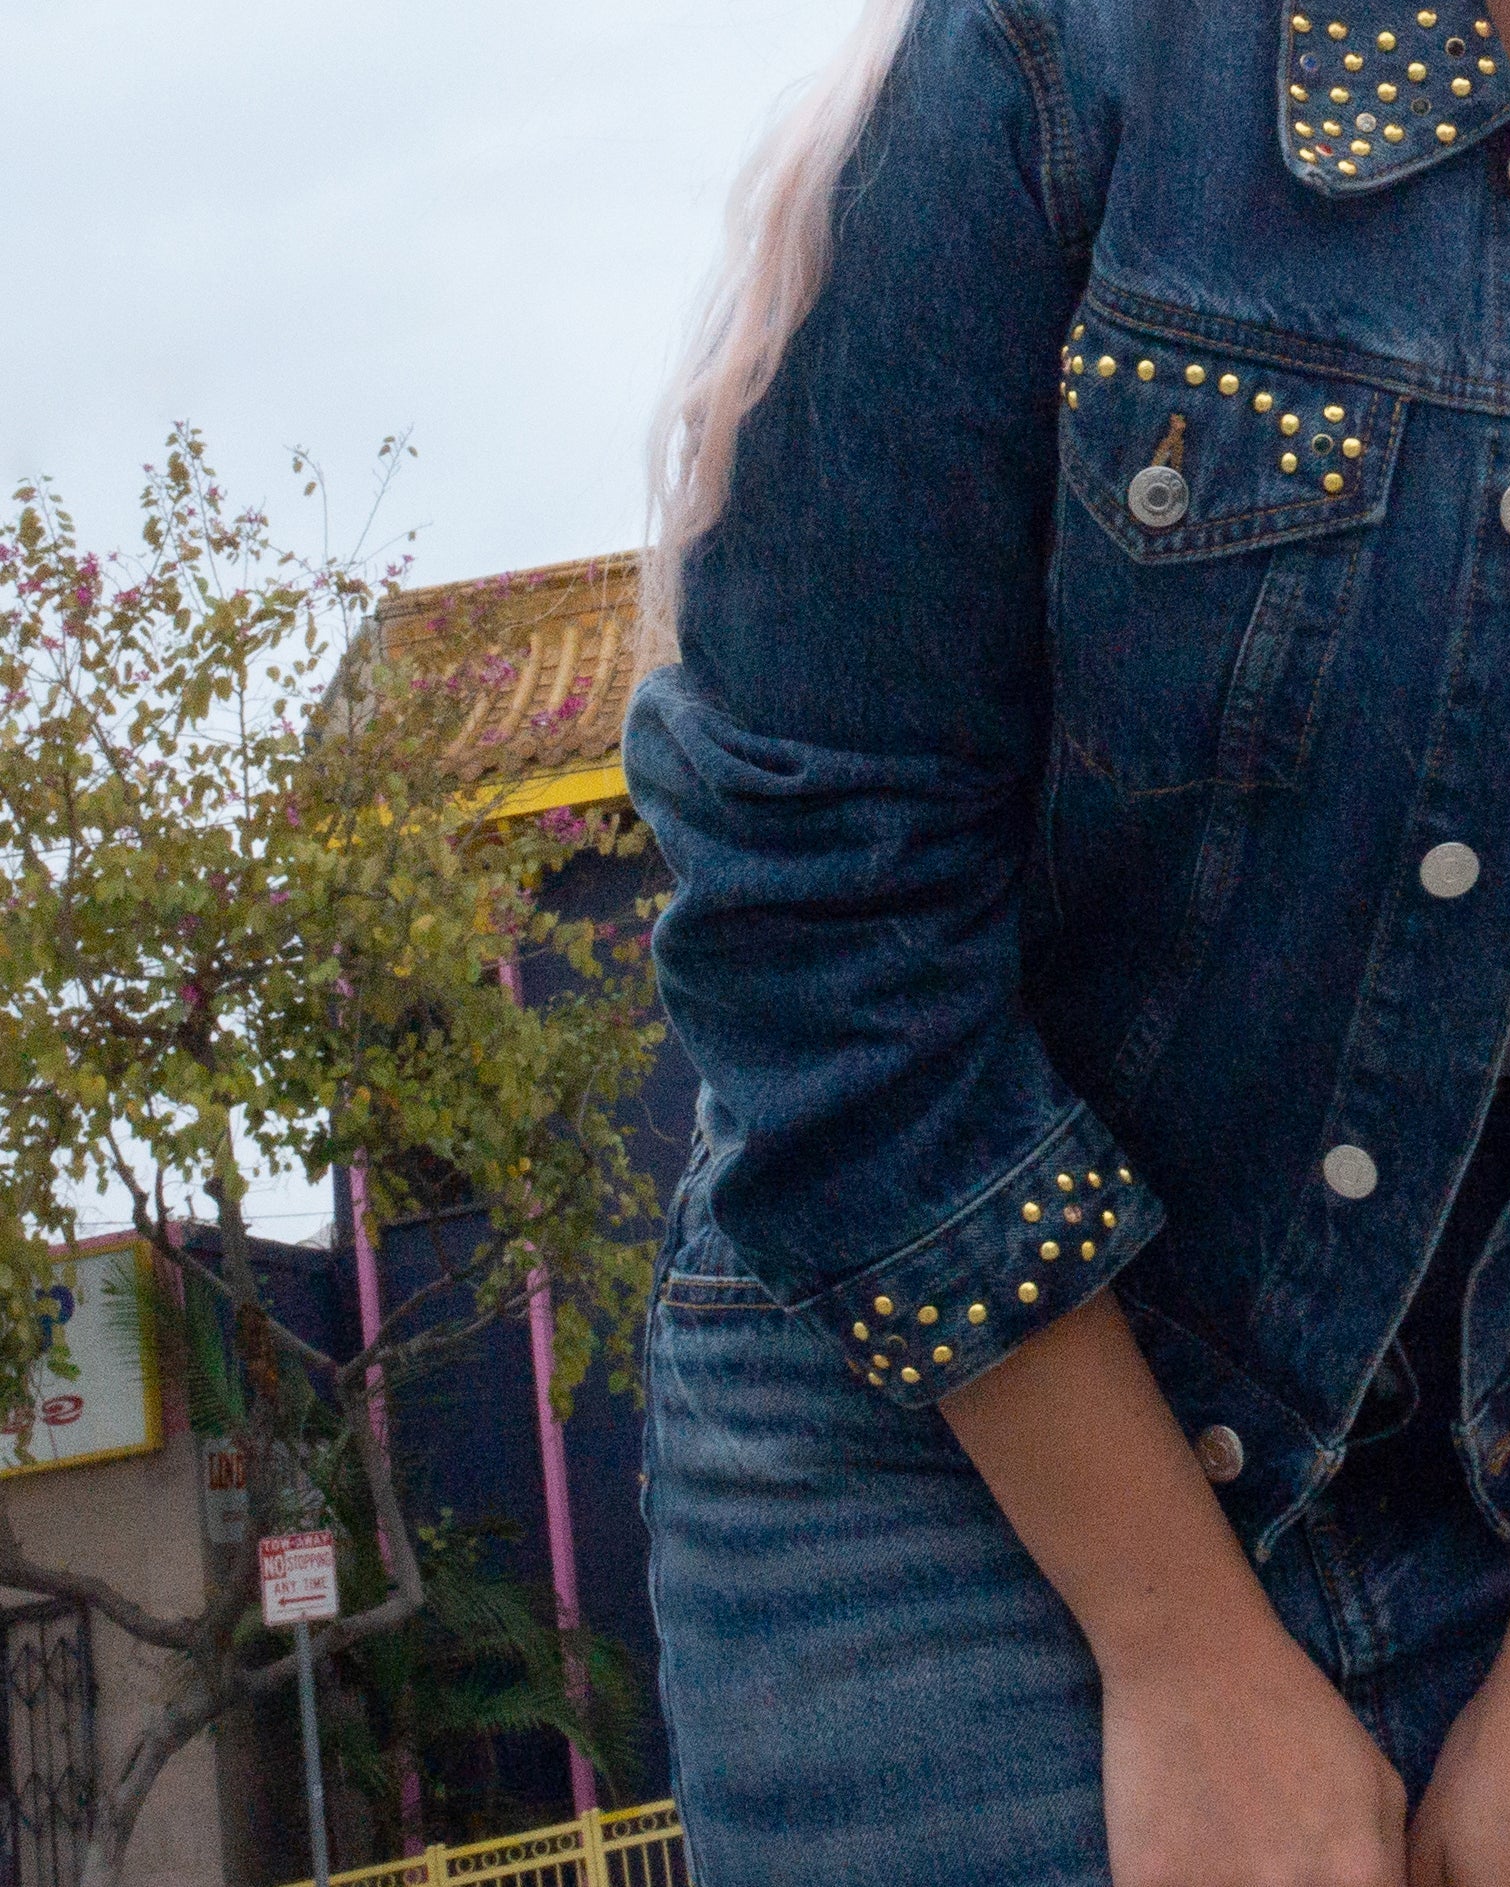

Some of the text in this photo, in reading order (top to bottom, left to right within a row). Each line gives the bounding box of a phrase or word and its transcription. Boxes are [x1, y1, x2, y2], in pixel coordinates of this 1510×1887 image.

[263, 1555, 285, 1578] NO
[274, 1575, 329, 1595] ANY TIME
